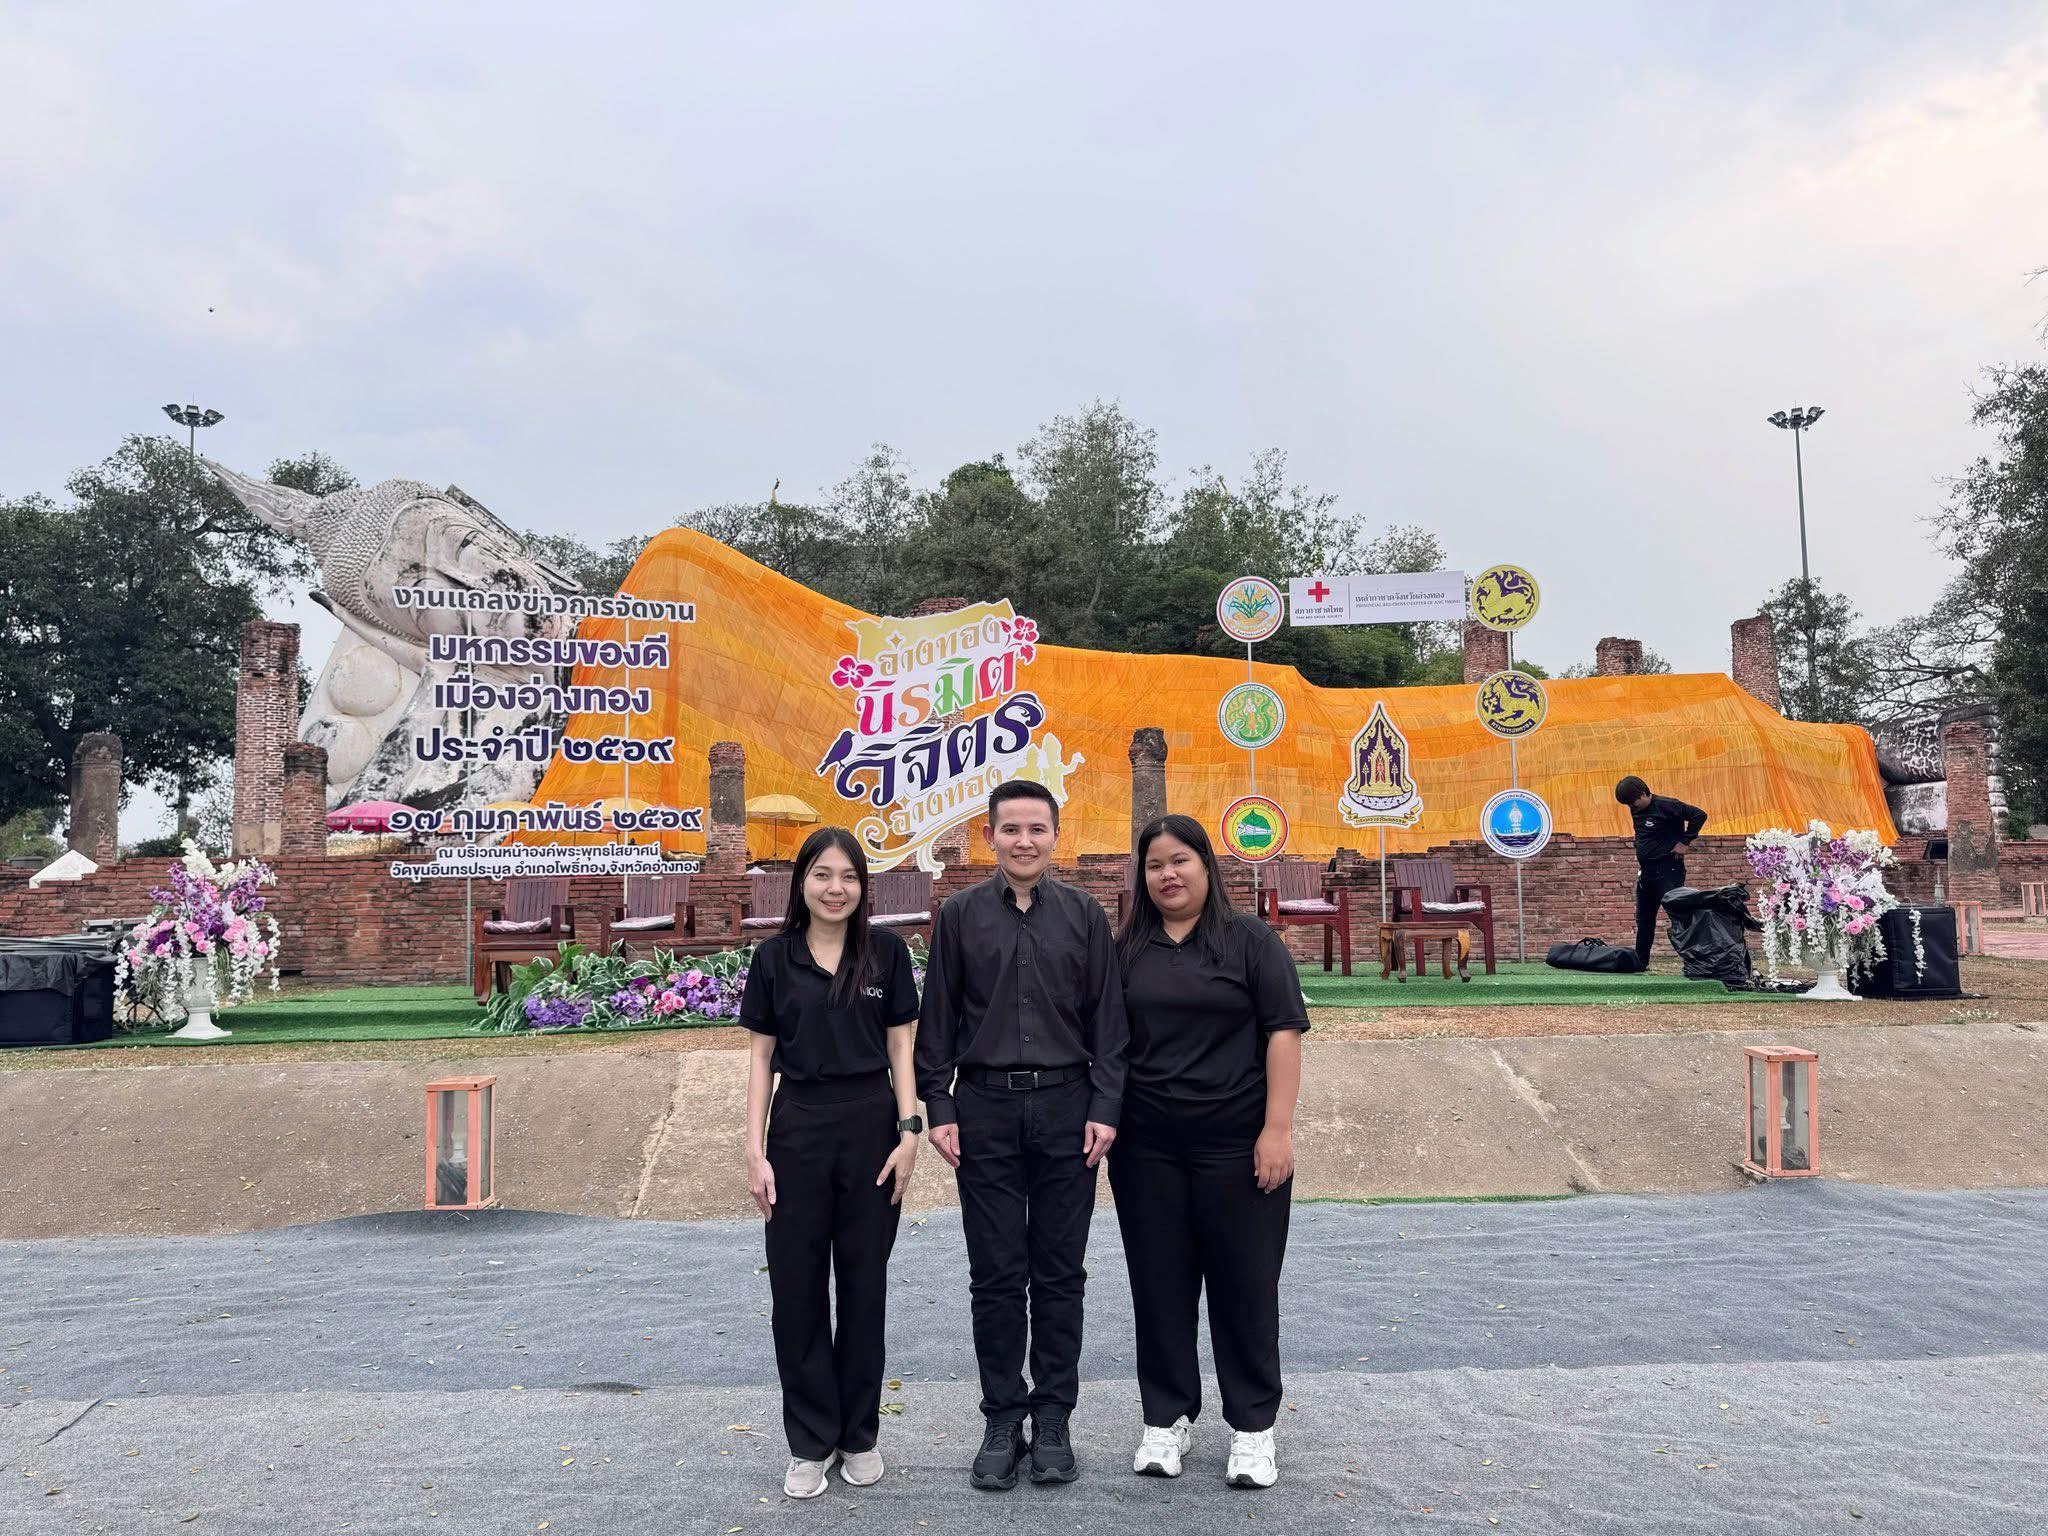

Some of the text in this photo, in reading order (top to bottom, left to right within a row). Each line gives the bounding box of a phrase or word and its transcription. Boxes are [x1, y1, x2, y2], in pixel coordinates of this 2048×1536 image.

[394, 586, 696, 621] งานแถลงข่าวการจัดงาน
[431, 633, 669, 667] มหกรรมของดี
[434, 675, 650, 713] เมืองอ่างทอง
[856, 650, 1015, 737] นิรมิต
[416, 727, 674, 763] ประจำปี ๒๕๖๙
[836, 693, 1046, 806] วิจิตร
[453, 803, 601, 840] กุมภาพันธ์
[614, 809, 702, 830] ๒๕๖๙
[392, 858, 699, 880] วัดขุนอินทรประมูล อำเภอโพธิ์ทอง จังหวัดอ่างทอง
[439, 848, 452, 858] ณ
